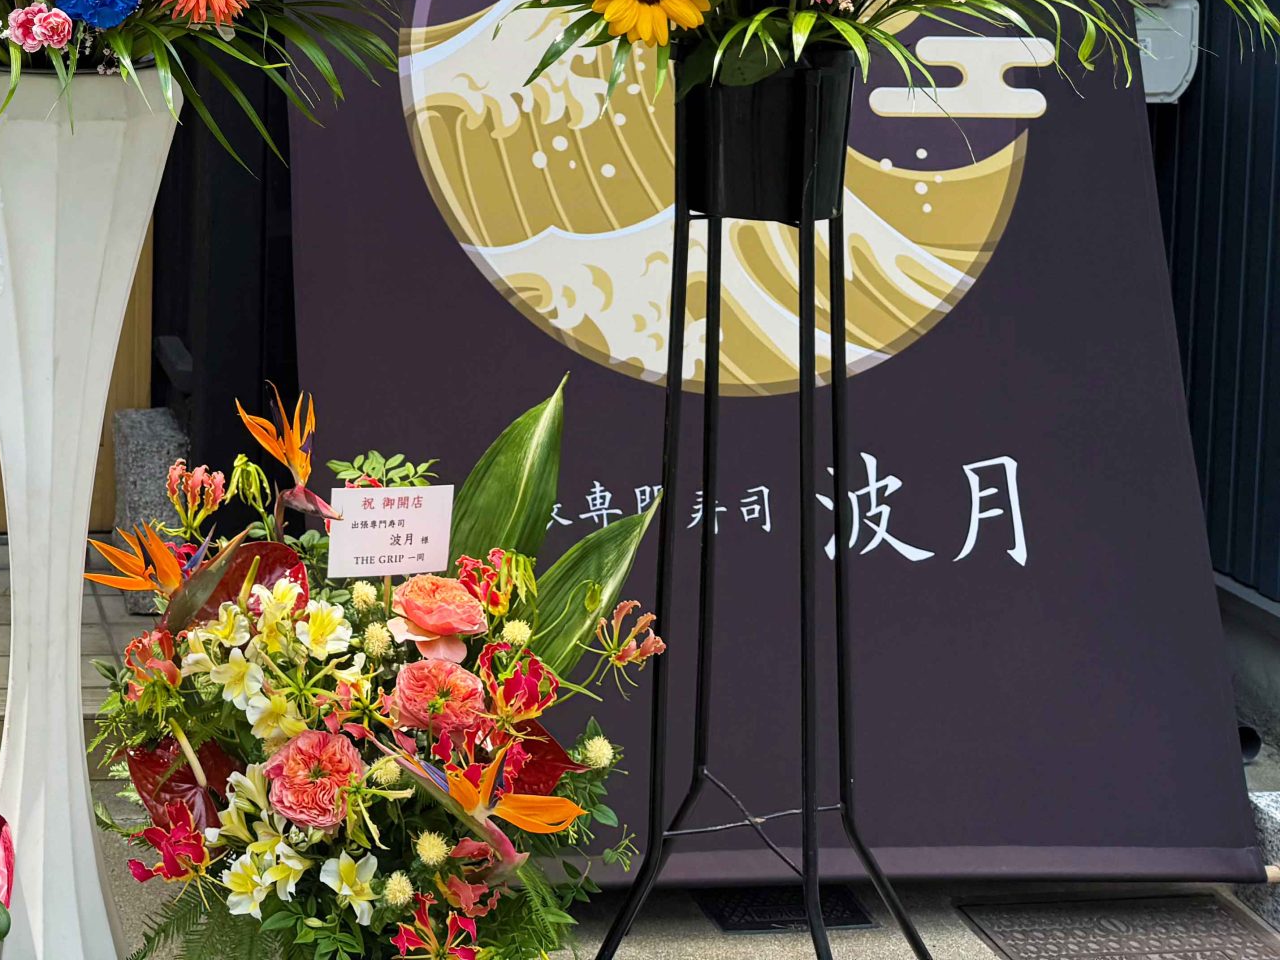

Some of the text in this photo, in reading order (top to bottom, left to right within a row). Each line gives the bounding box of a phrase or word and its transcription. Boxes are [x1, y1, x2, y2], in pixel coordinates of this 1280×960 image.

[361, 495, 424, 510] 祝 御開店
[816, 451, 1027, 567] 波月
[389, 533, 414, 546] 波月
[353, 555, 375, 565] THE
[378, 554, 405, 564] GRIP
